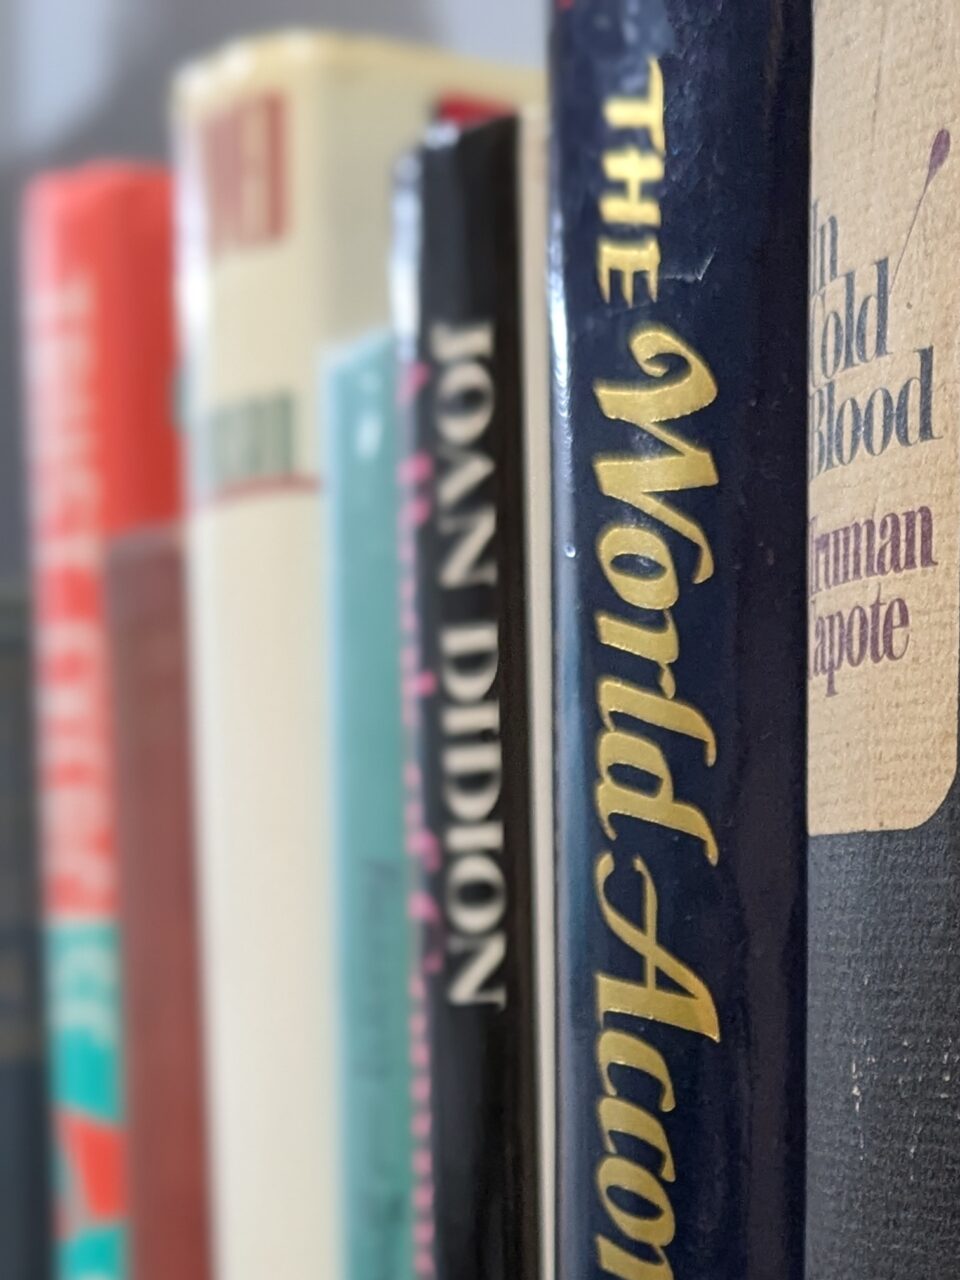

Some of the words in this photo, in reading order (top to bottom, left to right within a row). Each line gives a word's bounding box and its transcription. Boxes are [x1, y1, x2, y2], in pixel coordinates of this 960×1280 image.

[597, 55, 665, 309] THE
[429, 320, 500, 590] JOAN
[808, 345, 943, 481] Blood
[593, 325, 719, 867] World
[808, 581, 910, 698] apote
[439, 622, 508, 1010] DIDION
